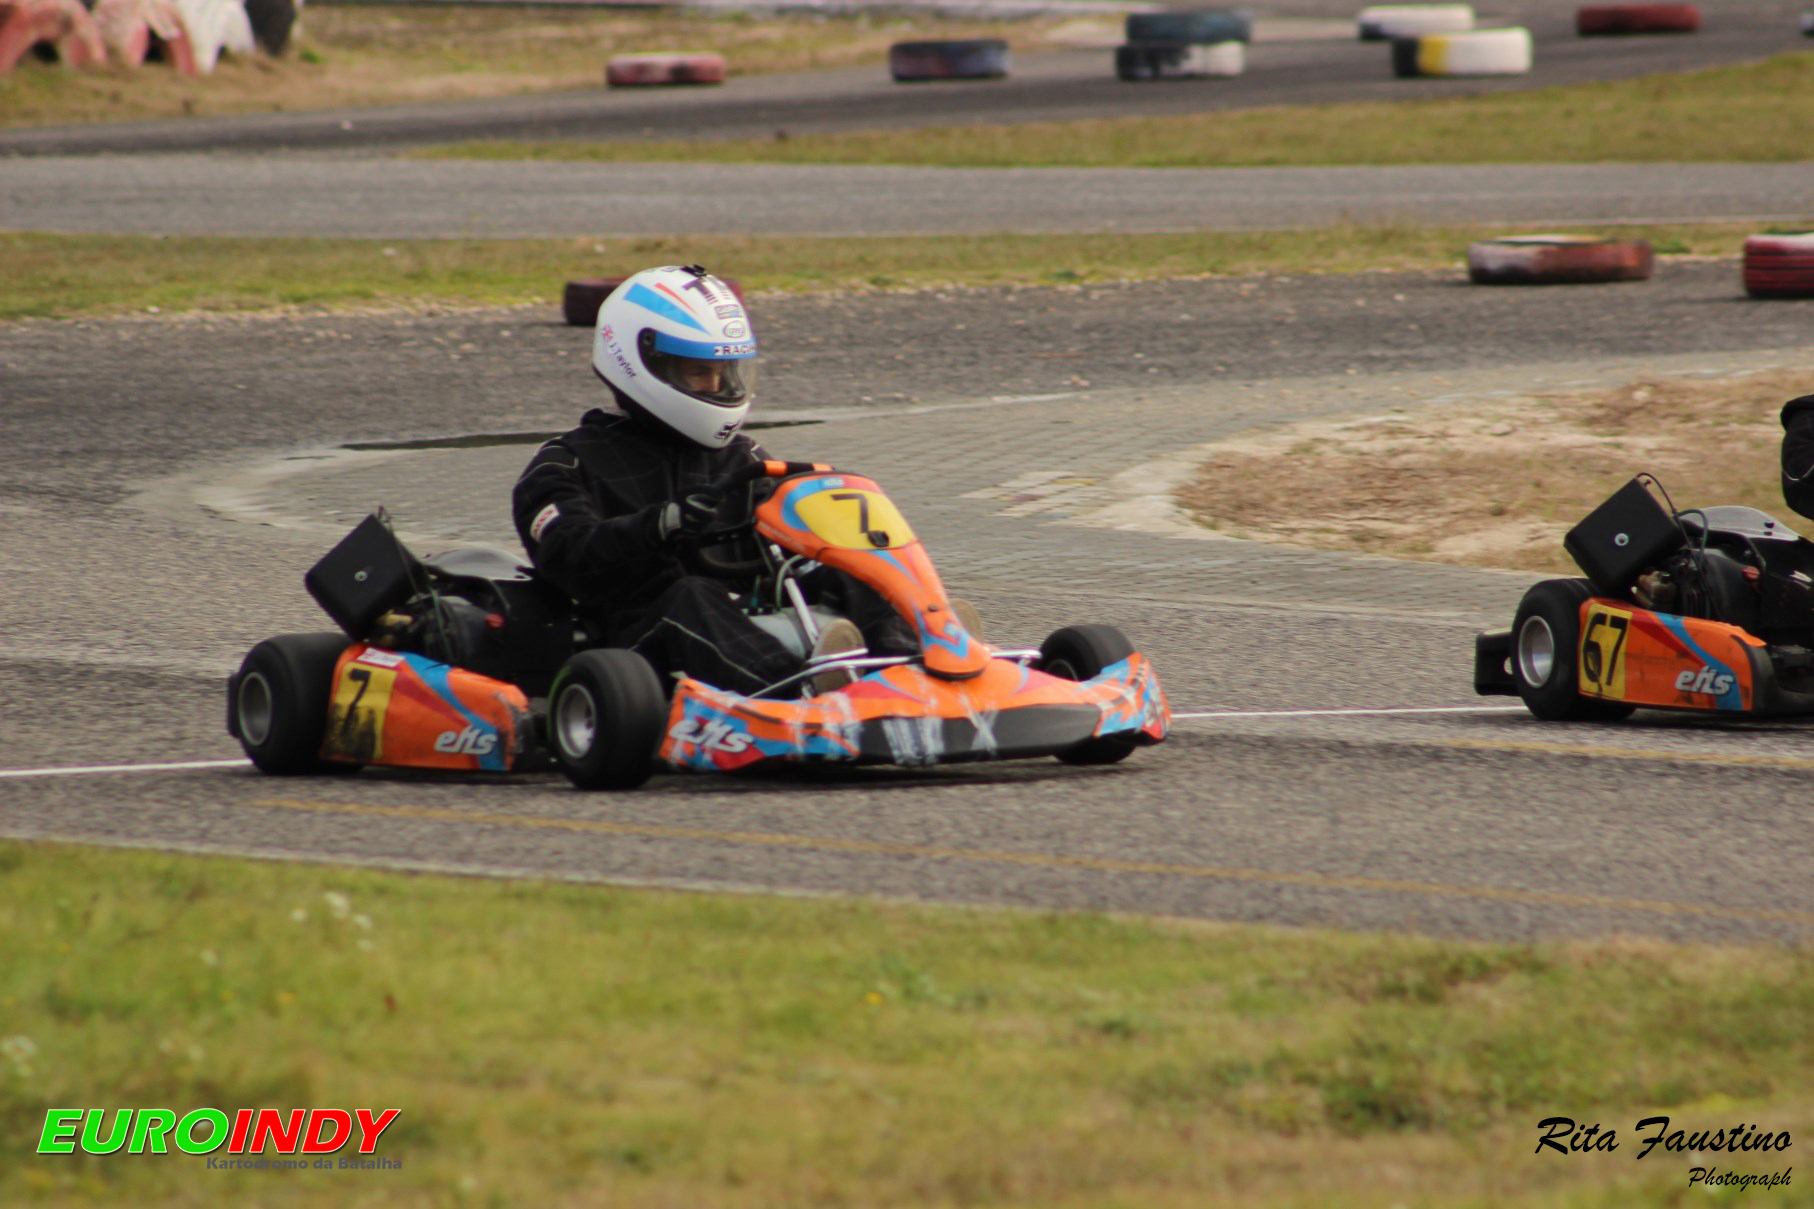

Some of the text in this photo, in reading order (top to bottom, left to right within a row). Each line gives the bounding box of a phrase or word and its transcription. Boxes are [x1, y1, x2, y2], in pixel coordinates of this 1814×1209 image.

[829, 493, 869, 534] 7
[1582, 612, 1629, 687] 67
[341, 668, 371, 742] 7
